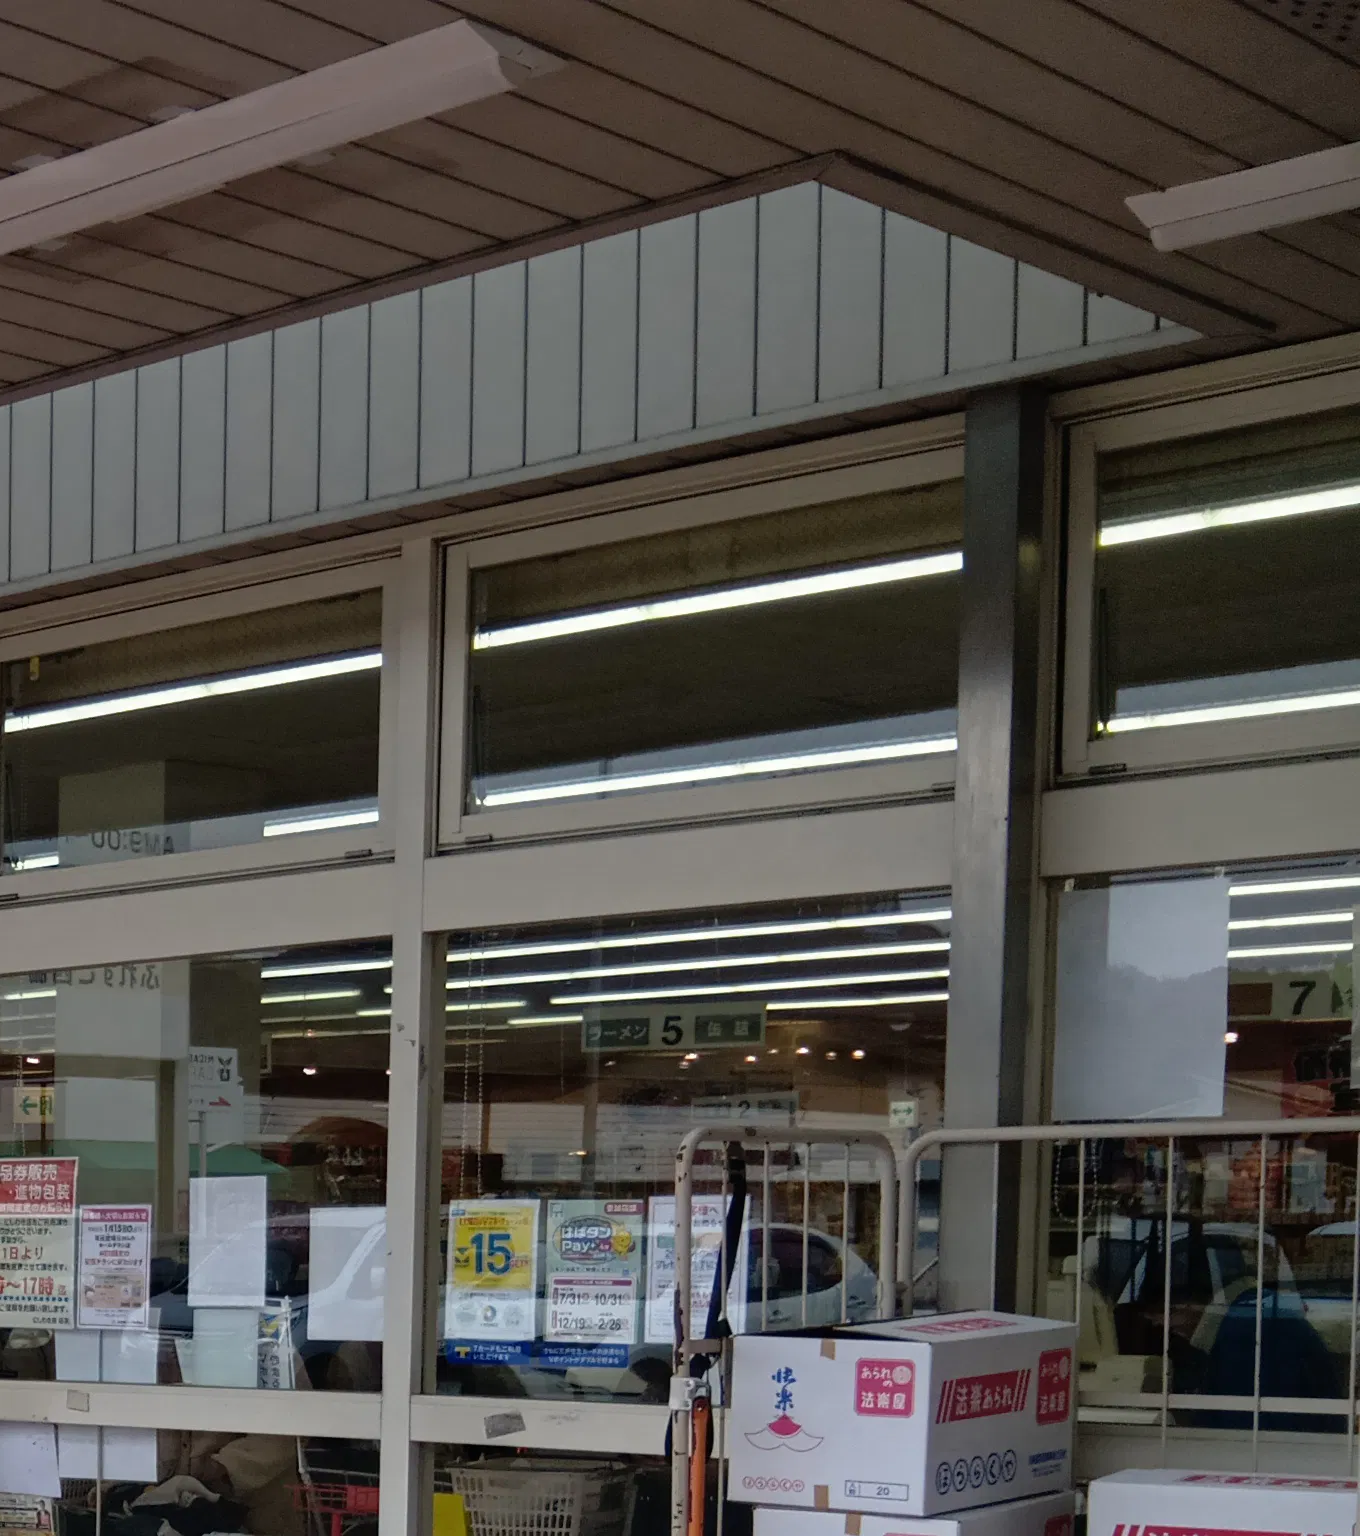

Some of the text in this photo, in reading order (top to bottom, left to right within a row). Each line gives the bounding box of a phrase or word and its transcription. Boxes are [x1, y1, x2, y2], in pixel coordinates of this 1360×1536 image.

[1289, 981, 1316, 1015] 7
[588, 1025, 648, 1041] ラーメン
[662, 1016, 684, 1045] 5
[561, 1226, 612, 1239] はばタン
[470, 1233, 512, 1275] 15
[559, 1293, 623, 1306] 7/31 10/31
[861, 1365, 892, 1380] あられ
[882, 1379, 893, 1387] の
[861, 1391, 907, 1410] 法楽屋
[955, 1382, 1014, 1417] 法楽あられ
[937, 1449, 1017, 1495] ほうらくや
[876, 1486, 891, 1496] 20
